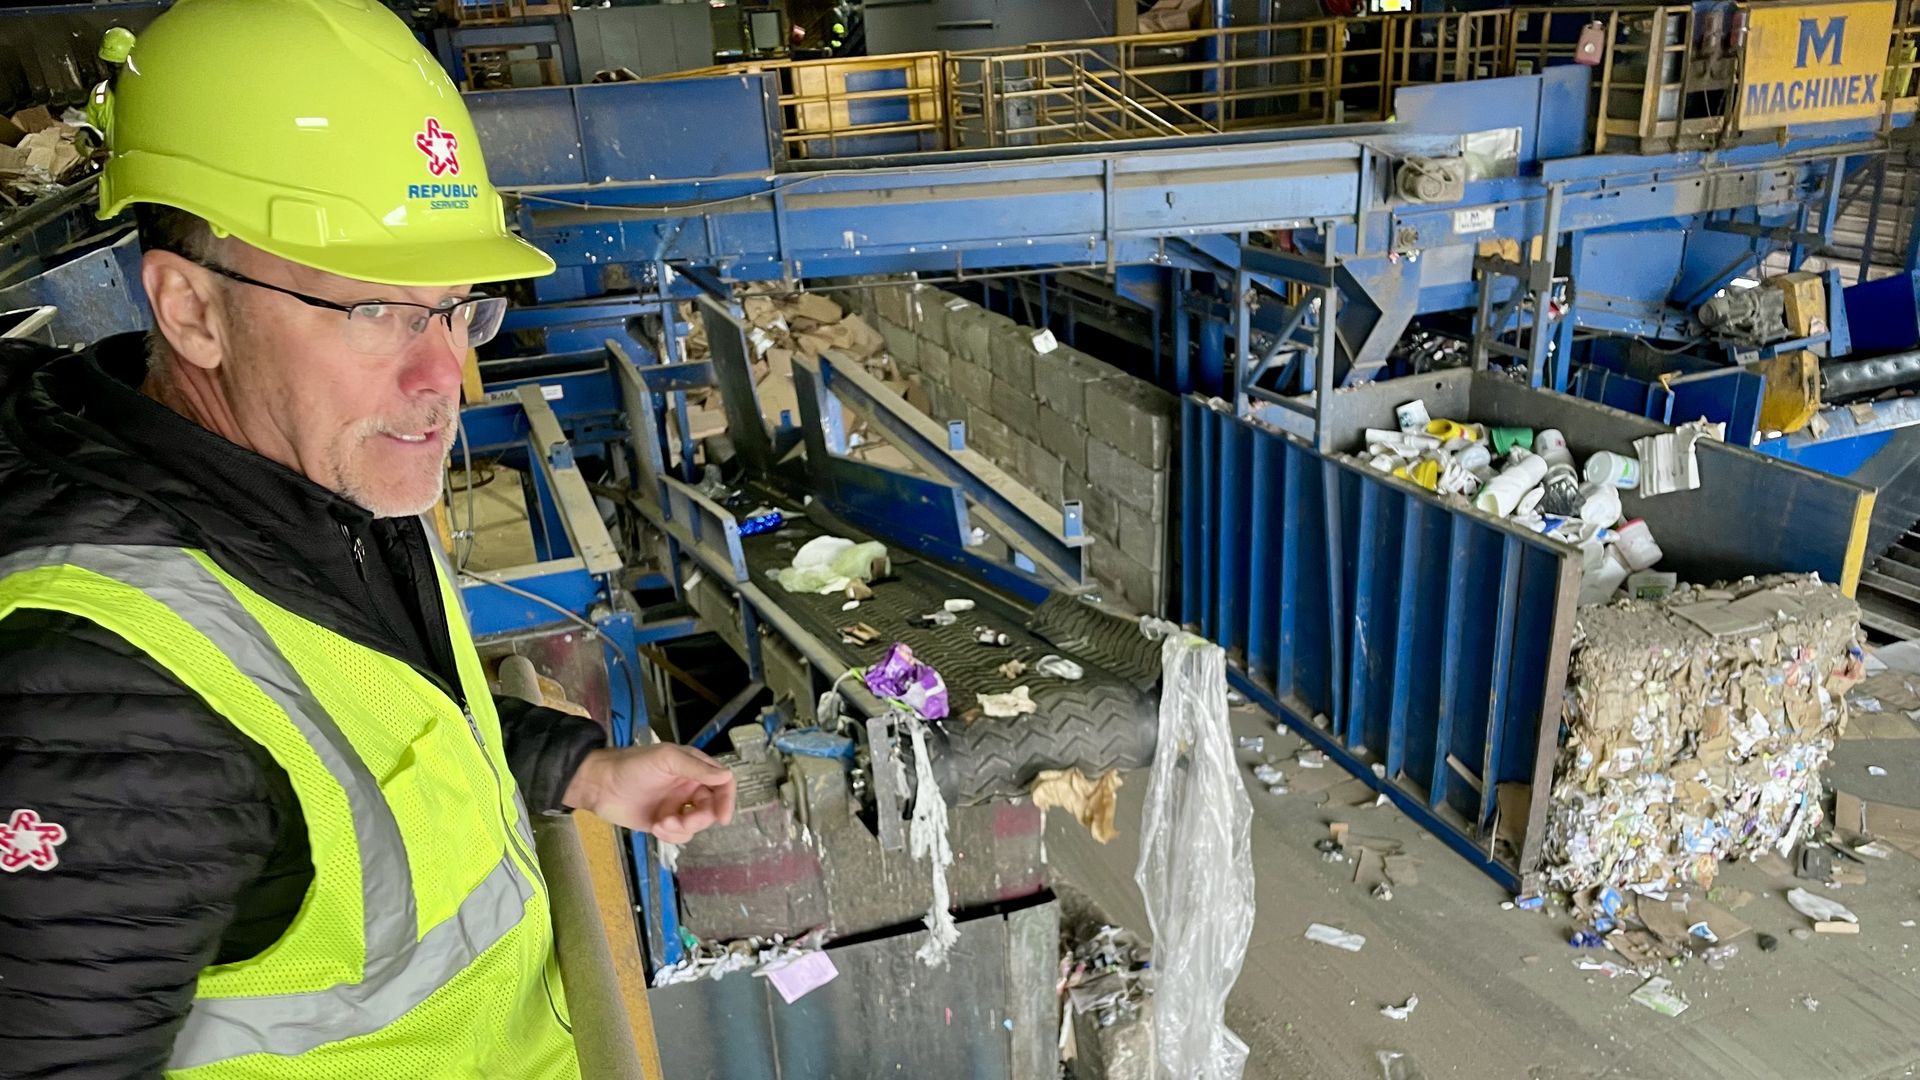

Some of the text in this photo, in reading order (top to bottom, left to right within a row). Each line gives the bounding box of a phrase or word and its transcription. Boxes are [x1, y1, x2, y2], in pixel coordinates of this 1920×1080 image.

[1794, 16, 1847, 68] M
[1746, 74, 1877, 115] MACHINEX
[408, 184, 478, 198] REPUBLIC
[430, 200, 469, 209] SERVICES
